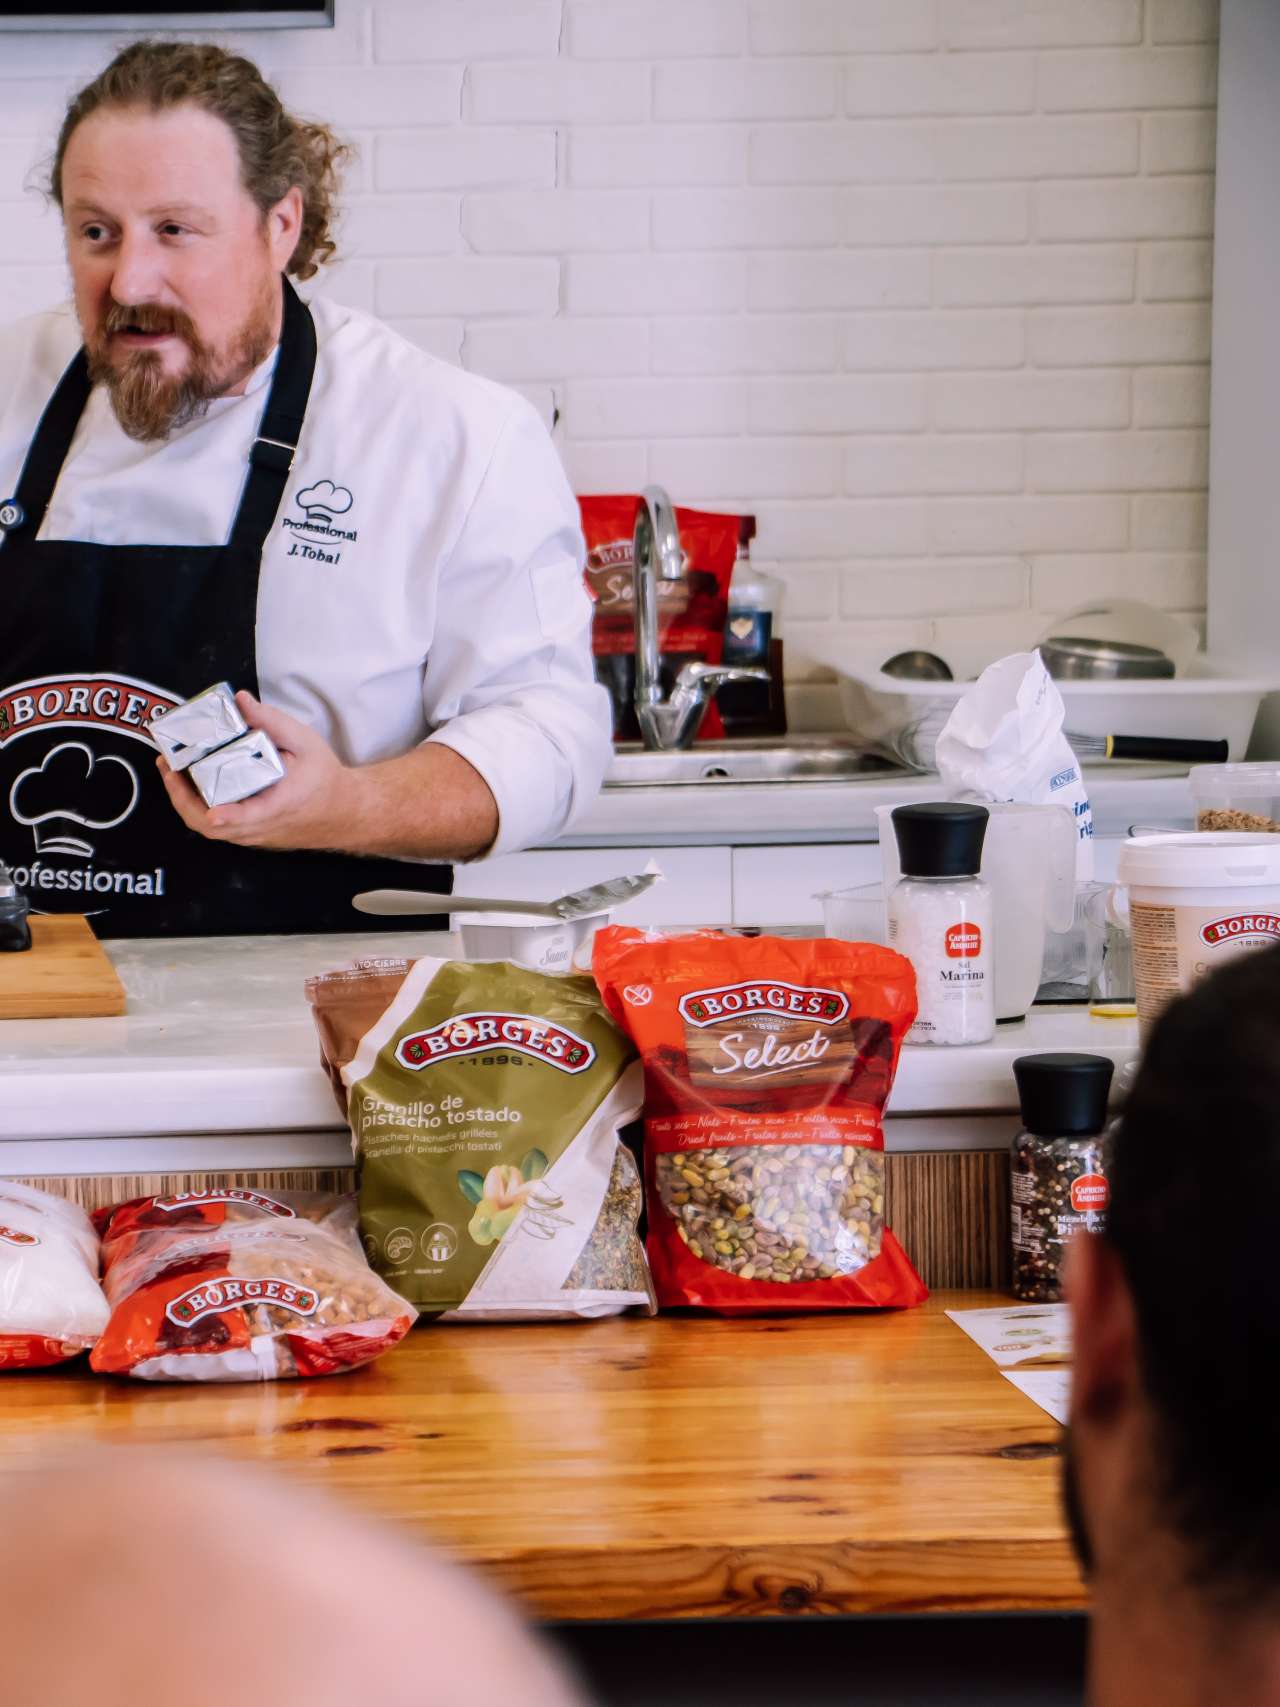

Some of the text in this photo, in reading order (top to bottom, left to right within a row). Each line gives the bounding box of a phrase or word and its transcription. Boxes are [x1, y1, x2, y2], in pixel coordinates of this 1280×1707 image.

[282, 518, 358, 542] Professional
[11, 686, 168, 727] BORGES
[351, 959, 407, 970] UTO-CIERRE
[940, 969, 984, 981] Marina
[701, 988, 823, 1015] BORGES
[424, 1019, 570, 1058] BORGES
[712, 1029, 832, 1074] Select
[362, 1094, 464, 1116] Granillo de
[362, 1106, 522, 1131] pistacho tostado
[404, 1143, 414, 1153] di
[186, 1281, 297, 1312] BORGES
